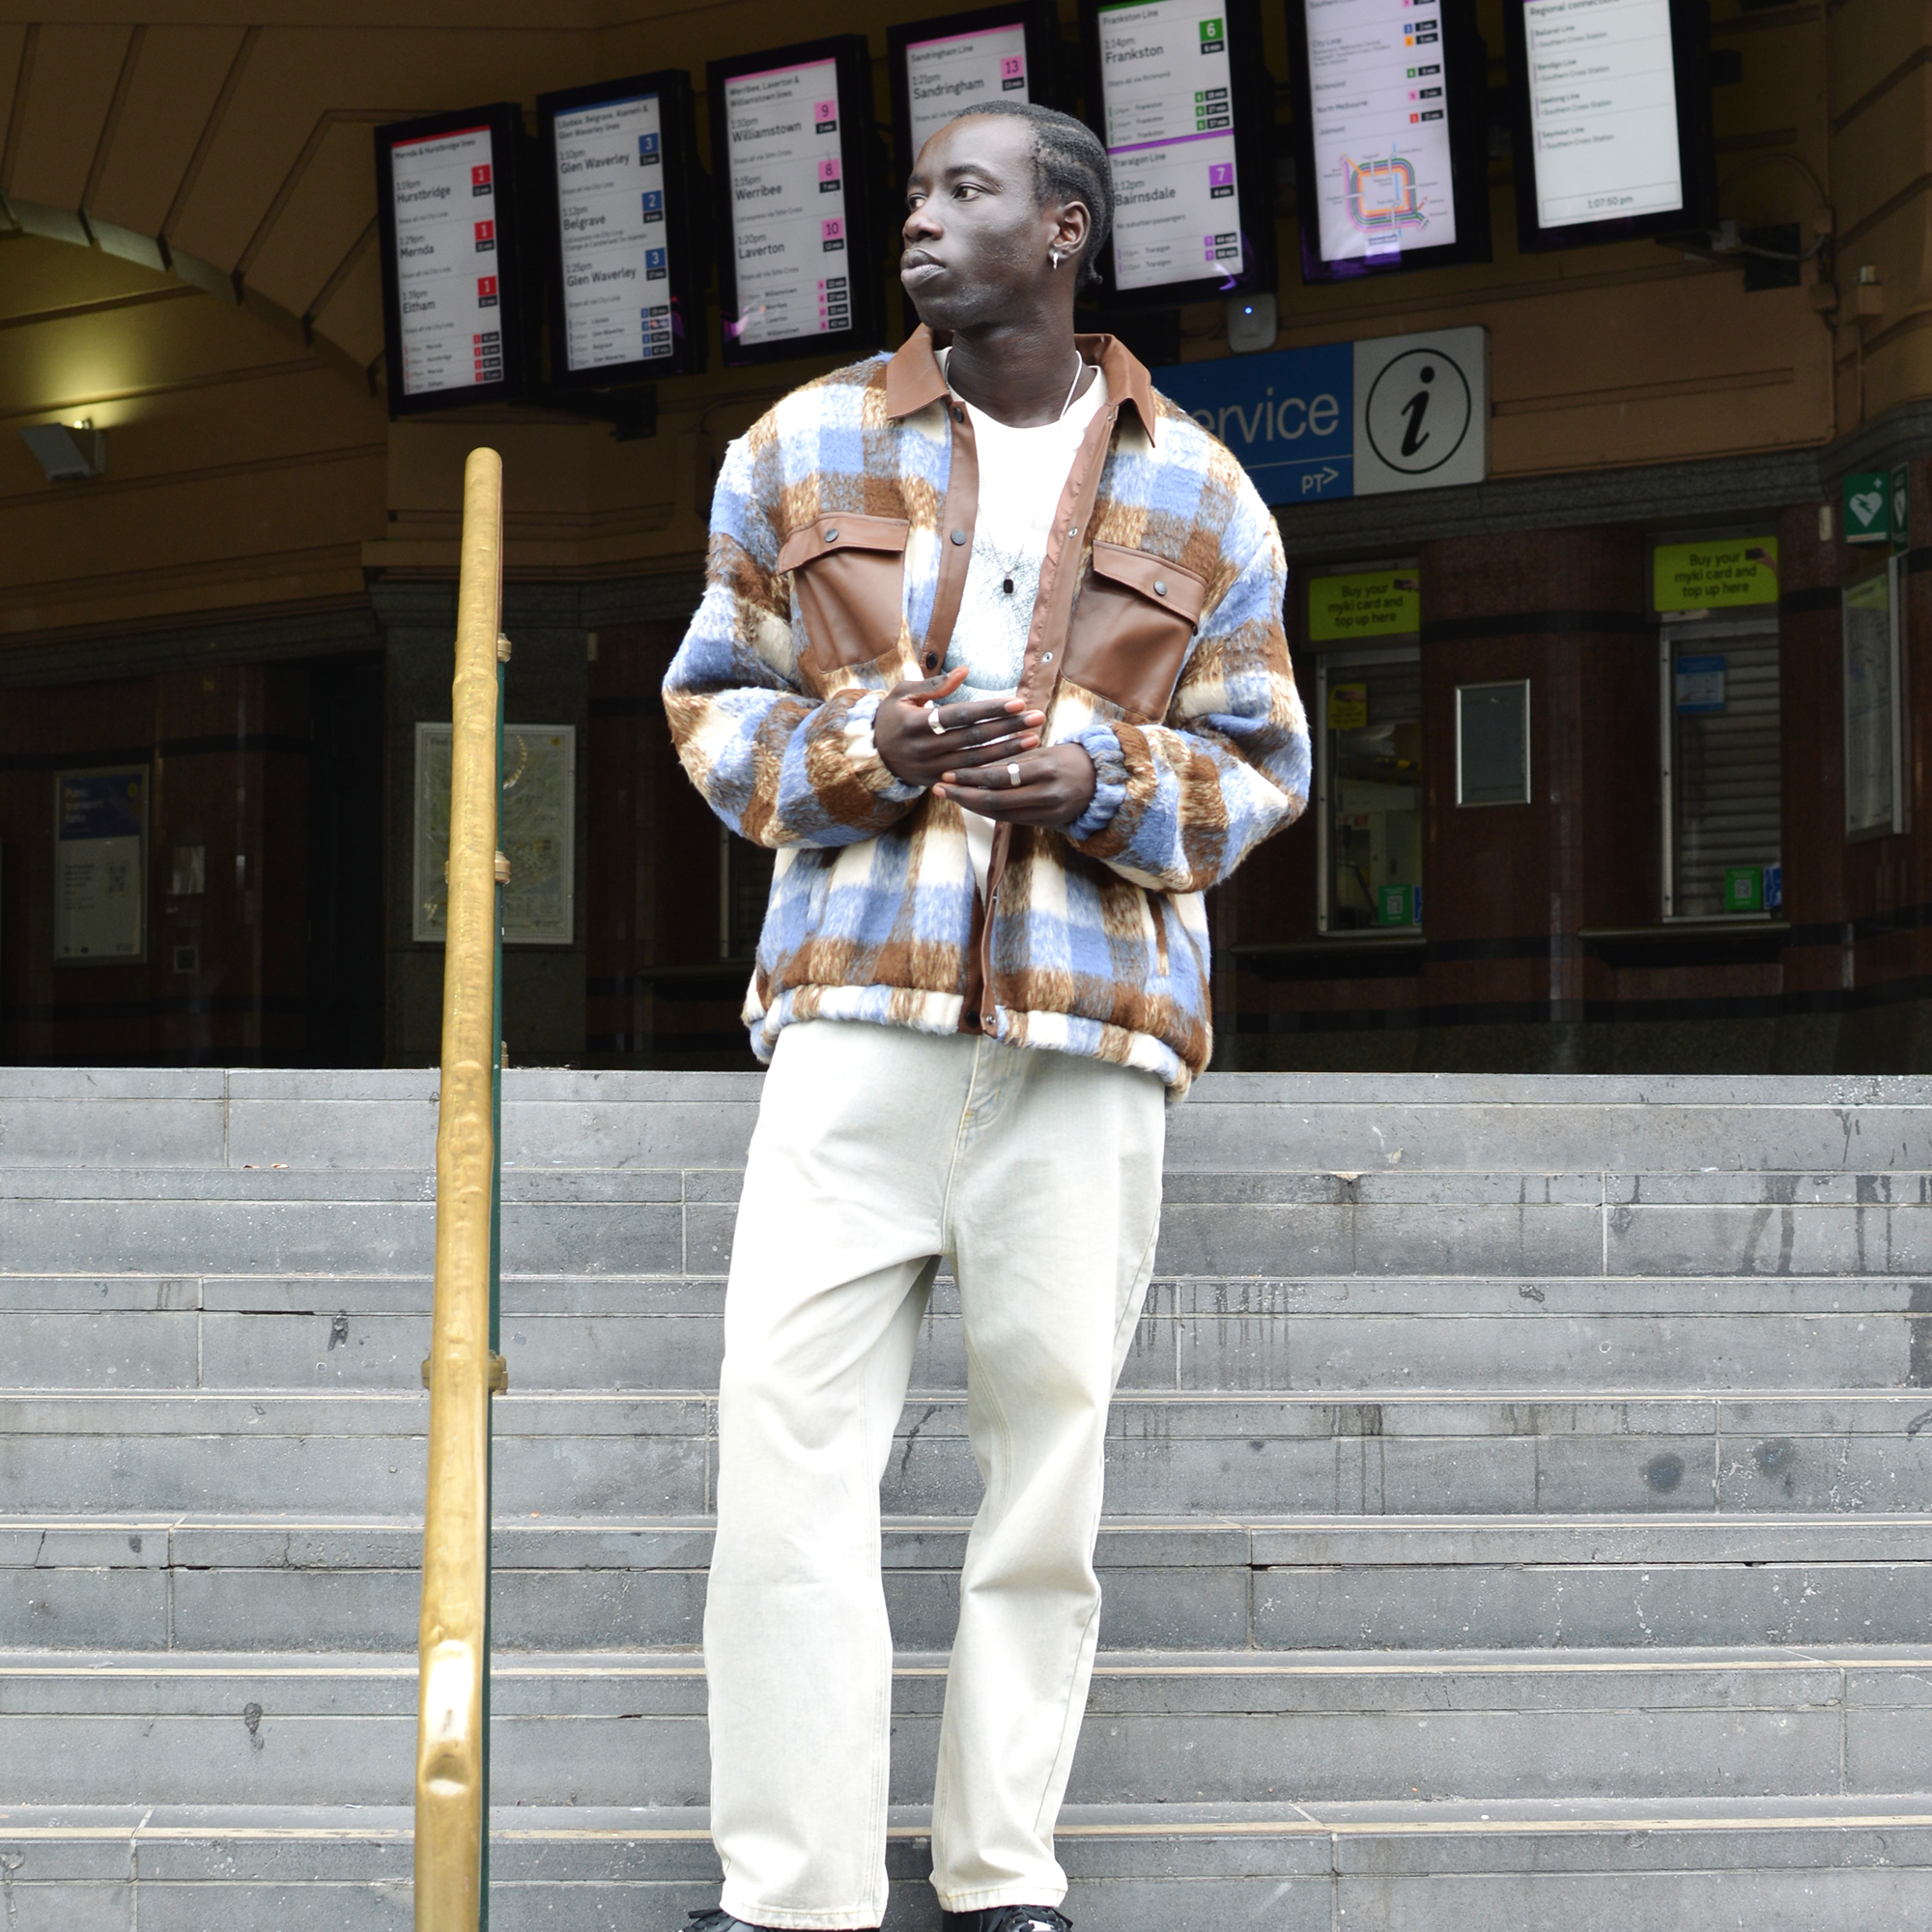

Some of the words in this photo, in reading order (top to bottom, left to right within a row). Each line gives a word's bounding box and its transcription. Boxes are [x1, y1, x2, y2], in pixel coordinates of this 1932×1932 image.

[1103, 13, 1141, 24] Frankston
[1143, 10, 1158, 18] Line
[1208, 23, 1215, 37] 6
[911, 48, 957, 62] Sandringham
[1106, 45, 1164, 64] Frankston
[1006, 60, 1018, 74] 13
[914, 79, 984, 100] Sandringham
[822, 104, 829, 117] 9
[576, 127, 603, 136] Waverley
[732, 122, 802, 142] Williamstown
[425, 142, 459, 154] Hurstbridge
[645, 137, 653, 150] 3
[560, 161, 582, 174] Glen
[584, 154, 630, 169] Waverley
[826, 163, 833, 176] 8
[478, 169, 484, 182] 1
[1216, 167, 1226, 182] 7
[398, 185, 451, 203] Hurstbridge
[735, 185, 782, 201] Werribee
[1115, 187, 1176, 207] Bairnsdale
[648, 194, 656, 208] 2
[563, 215, 606, 230] Belgrave
[827, 222, 838, 236] 10
[481, 224, 487, 237] 1
[400, 244, 435, 258] Mernda
[652, 252, 659, 265] 3
[738, 243, 784, 259] Laverton
[567, 275, 589, 287] Glen
[591, 268, 637, 283] Waverley
[484, 280, 490, 293] 1
[403, 300, 436, 314] Eltham
[1191, 388, 1339, 443] ervice
[1690, 554, 1712, 568] Buy
[1715, 553, 1741, 567] your
[1675, 569, 1703, 584] myki
[1706, 567, 1732, 580] card
[1735, 565, 1757, 578] and
[1342, 585, 1361, 599] Buy
[1365, 584, 1388, 597] your
[1683, 586, 1702, 599] top
[1705, 585, 1719, 598] up
[1722, 582, 1749, 593] here
[1328, 600, 1354, 615] myki
[1356, 598, 1380, 611] card
[1383, 596, 1404, 608] and
[1336, 616, 1353, 628] top
[1355, 615, 1370, 627] up
[1372, 612, 1396, 623] here
